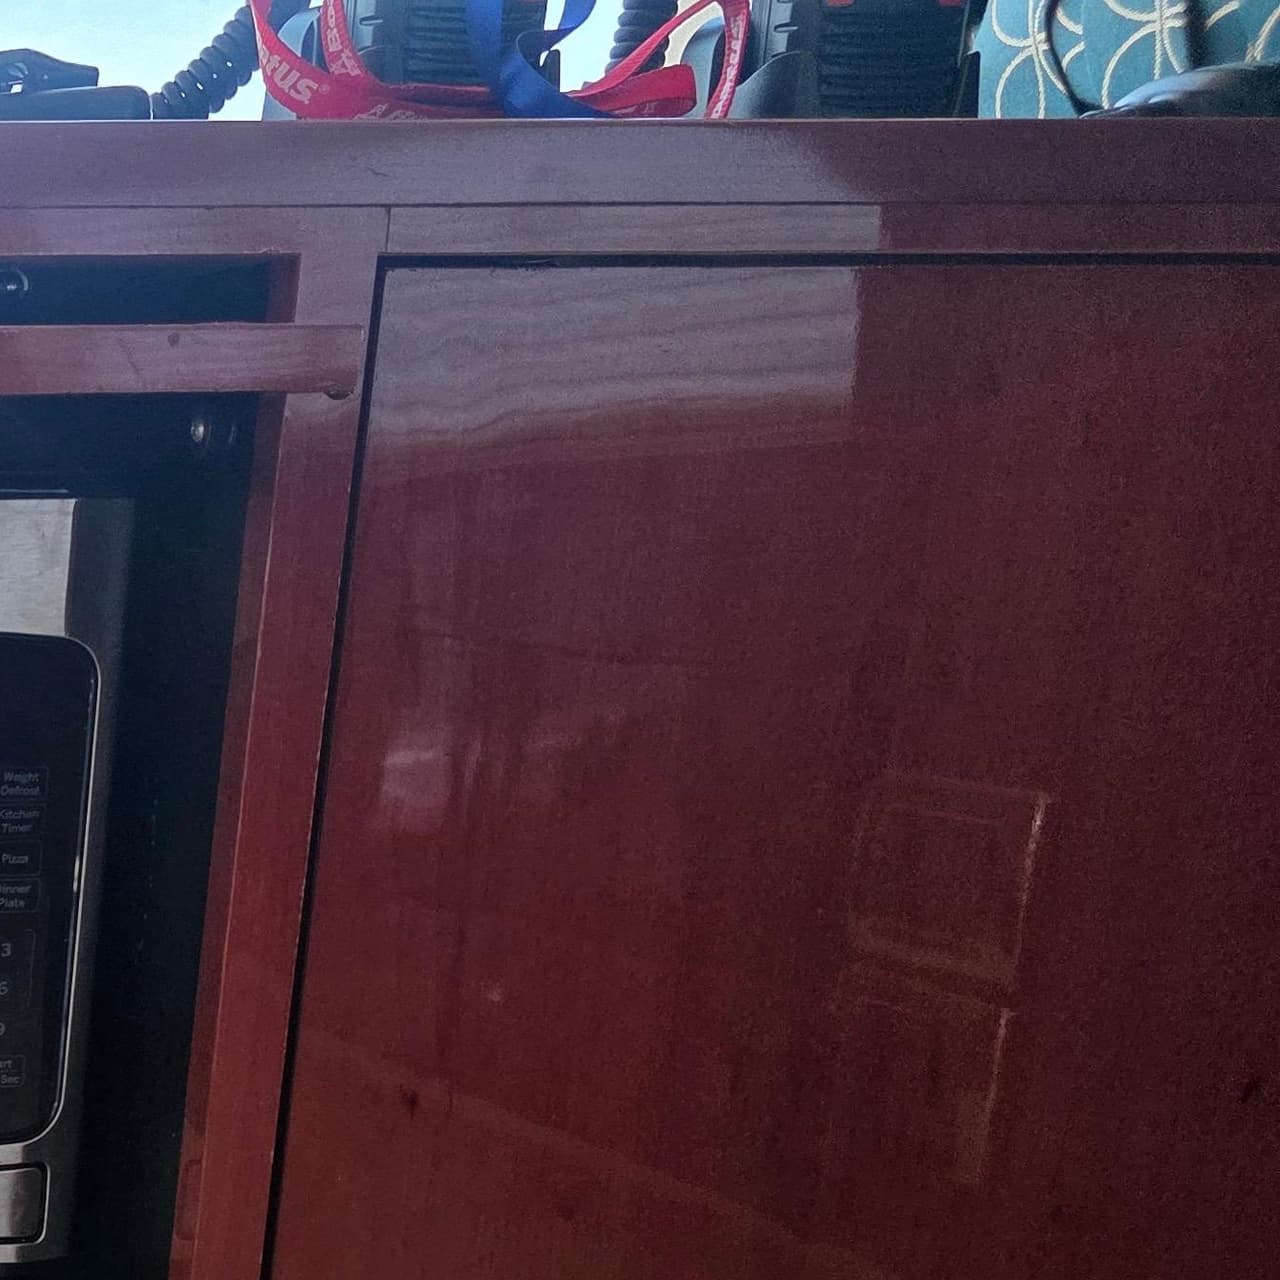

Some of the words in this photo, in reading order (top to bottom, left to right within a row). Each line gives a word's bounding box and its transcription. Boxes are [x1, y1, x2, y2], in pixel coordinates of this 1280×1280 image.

[1, 823, 32, 833] Timer
[2, 855, 29, 864] Pizza
[1, 943, 11, 957] 3
[0, 1074, 20, 1085] Sec
